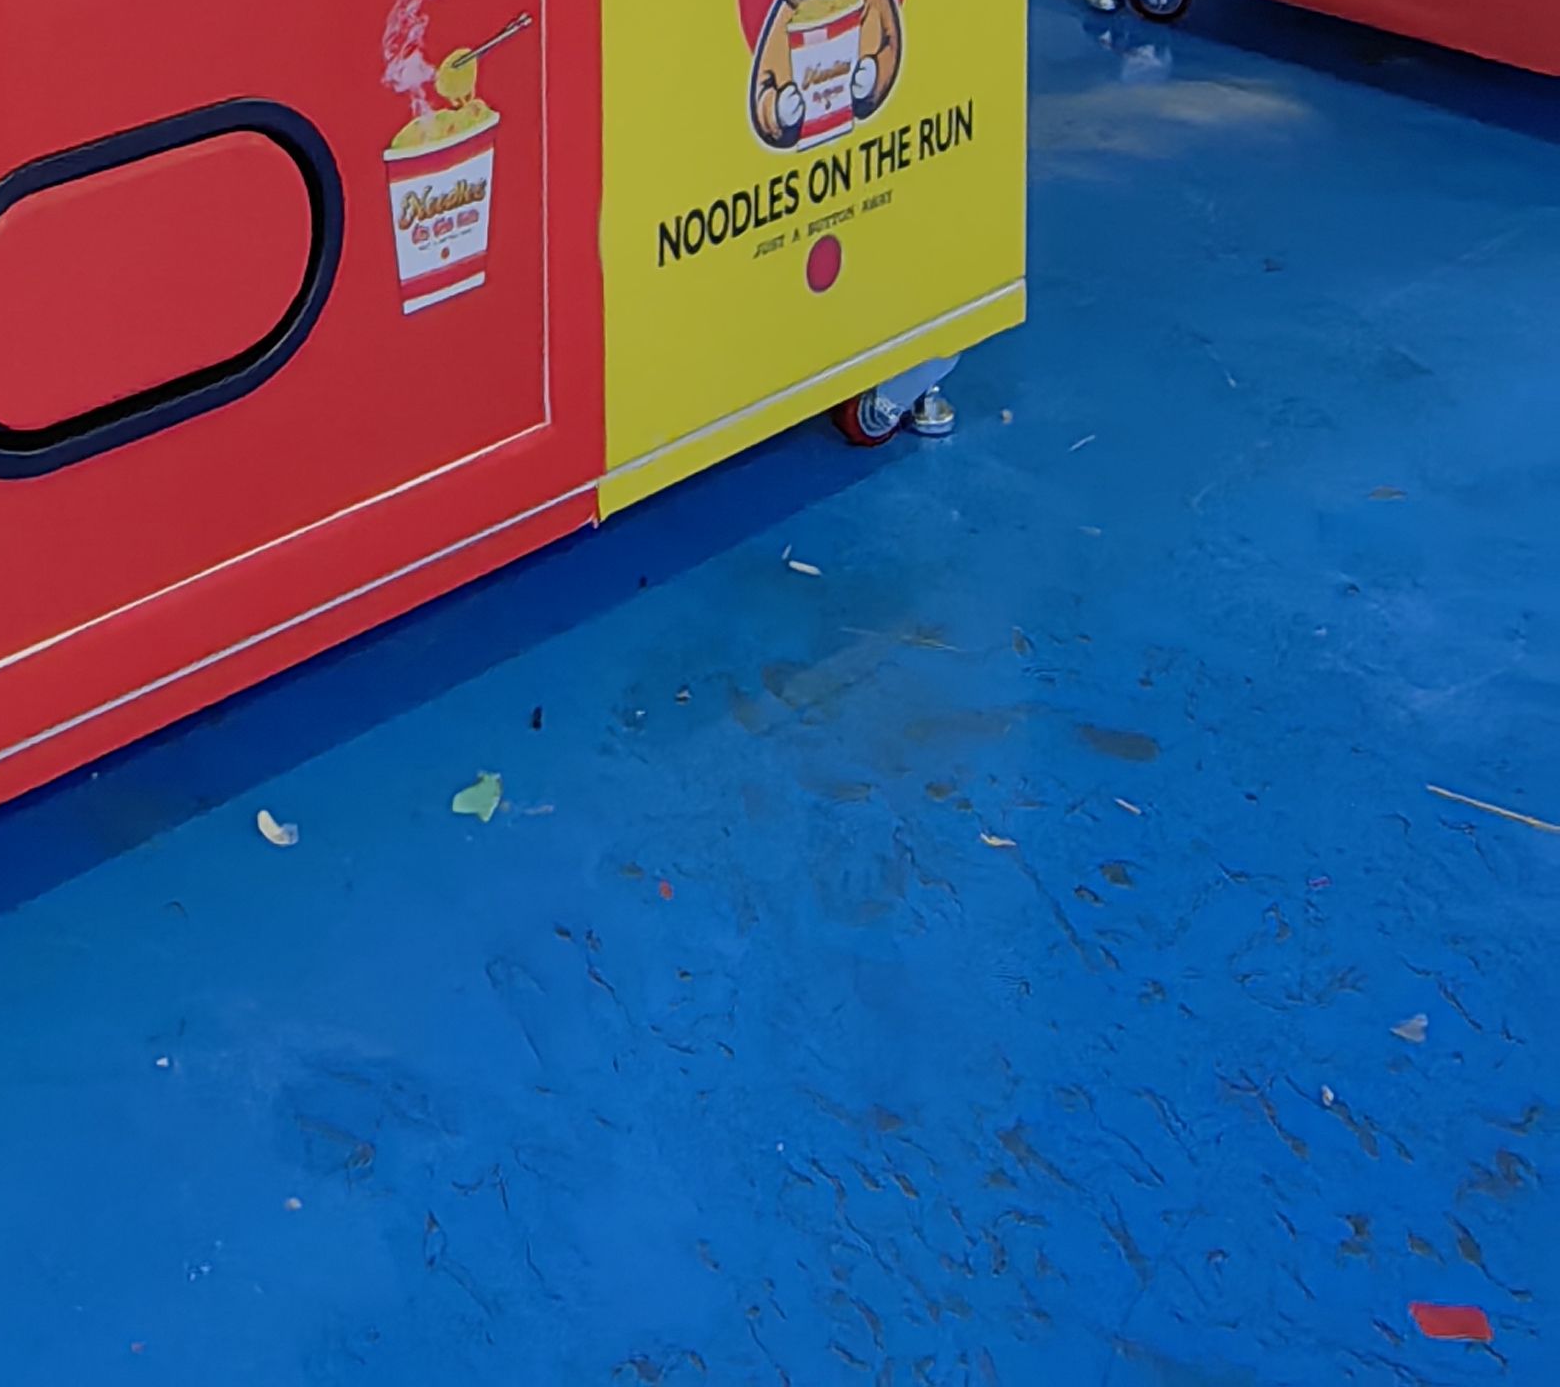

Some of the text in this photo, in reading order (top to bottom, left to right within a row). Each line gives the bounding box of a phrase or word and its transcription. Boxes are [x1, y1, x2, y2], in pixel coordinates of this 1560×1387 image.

[657, 99, 974, 268] NOODLES ON THE RUN
